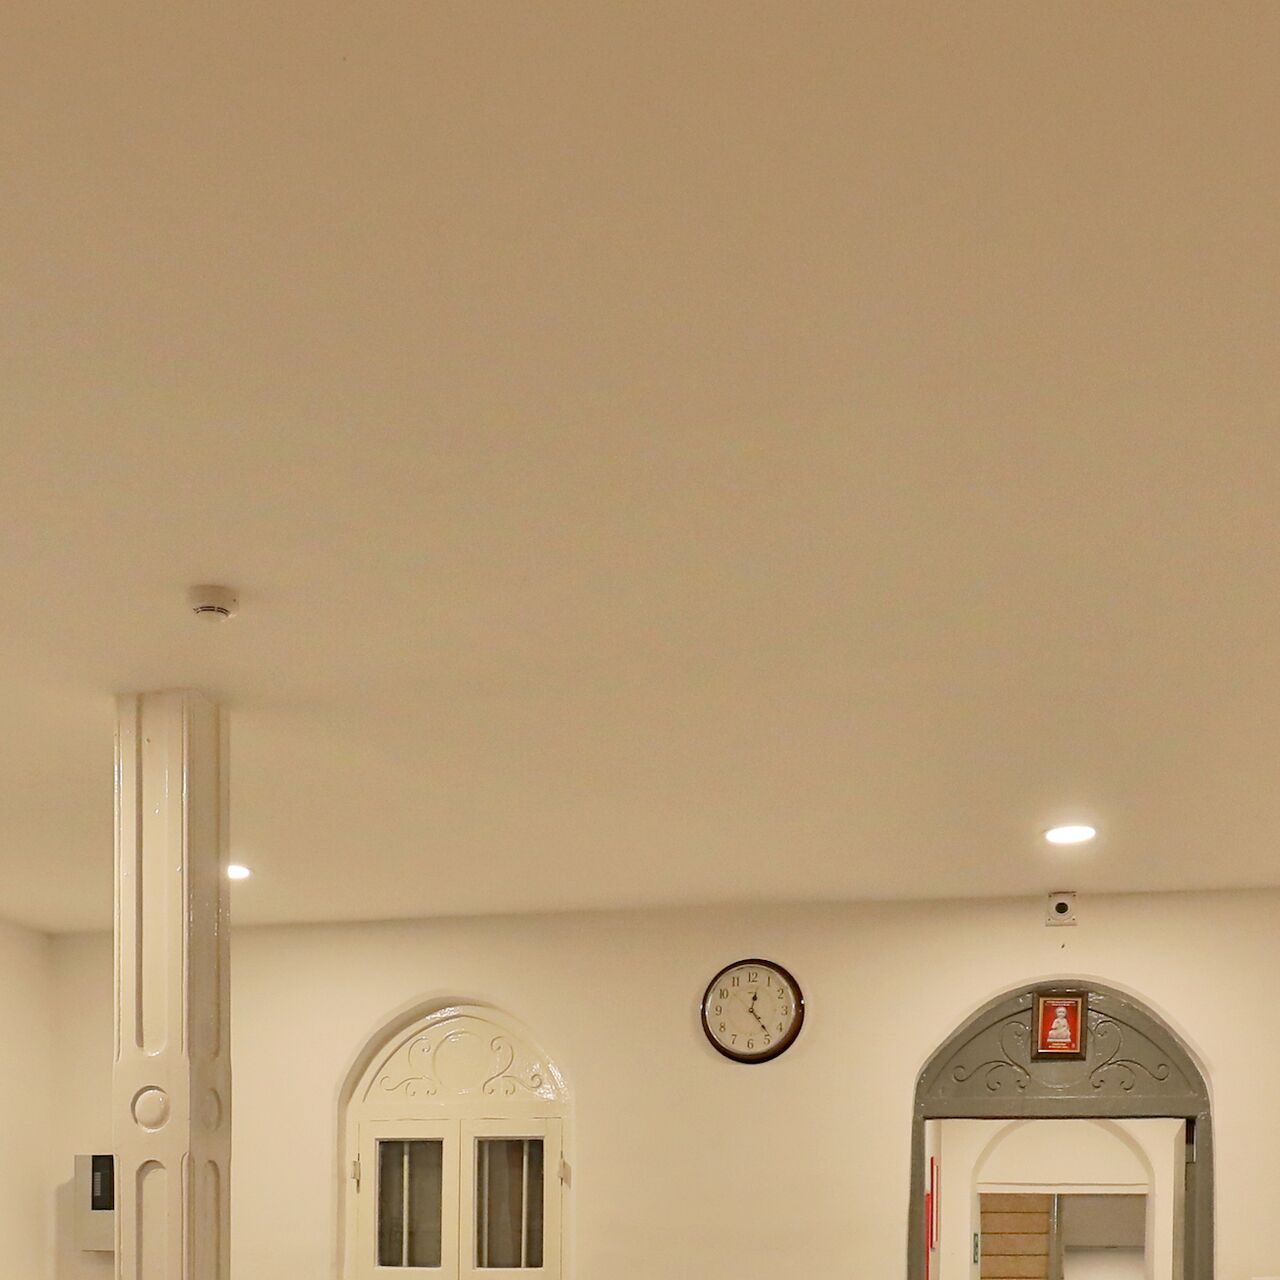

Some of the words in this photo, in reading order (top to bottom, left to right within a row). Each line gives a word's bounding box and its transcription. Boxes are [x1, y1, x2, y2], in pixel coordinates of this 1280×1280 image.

[732, 976, 740, 987] 11
[748, 972, 758, 983] 12
[719, 988, 729, 999] 10
[777, 988, 784, 999] 2
[715, 1005, 722, 1016] 9
[781, 1005, 788, 1016] 3
[719, 1022, 726, 1032] 8
[776, 1021, 783, 1032] 4
[731, 1034, 738, 1045] 7
[747, 1039, 754, 1049] 6
[764, 1035, 771, 1045] 5
